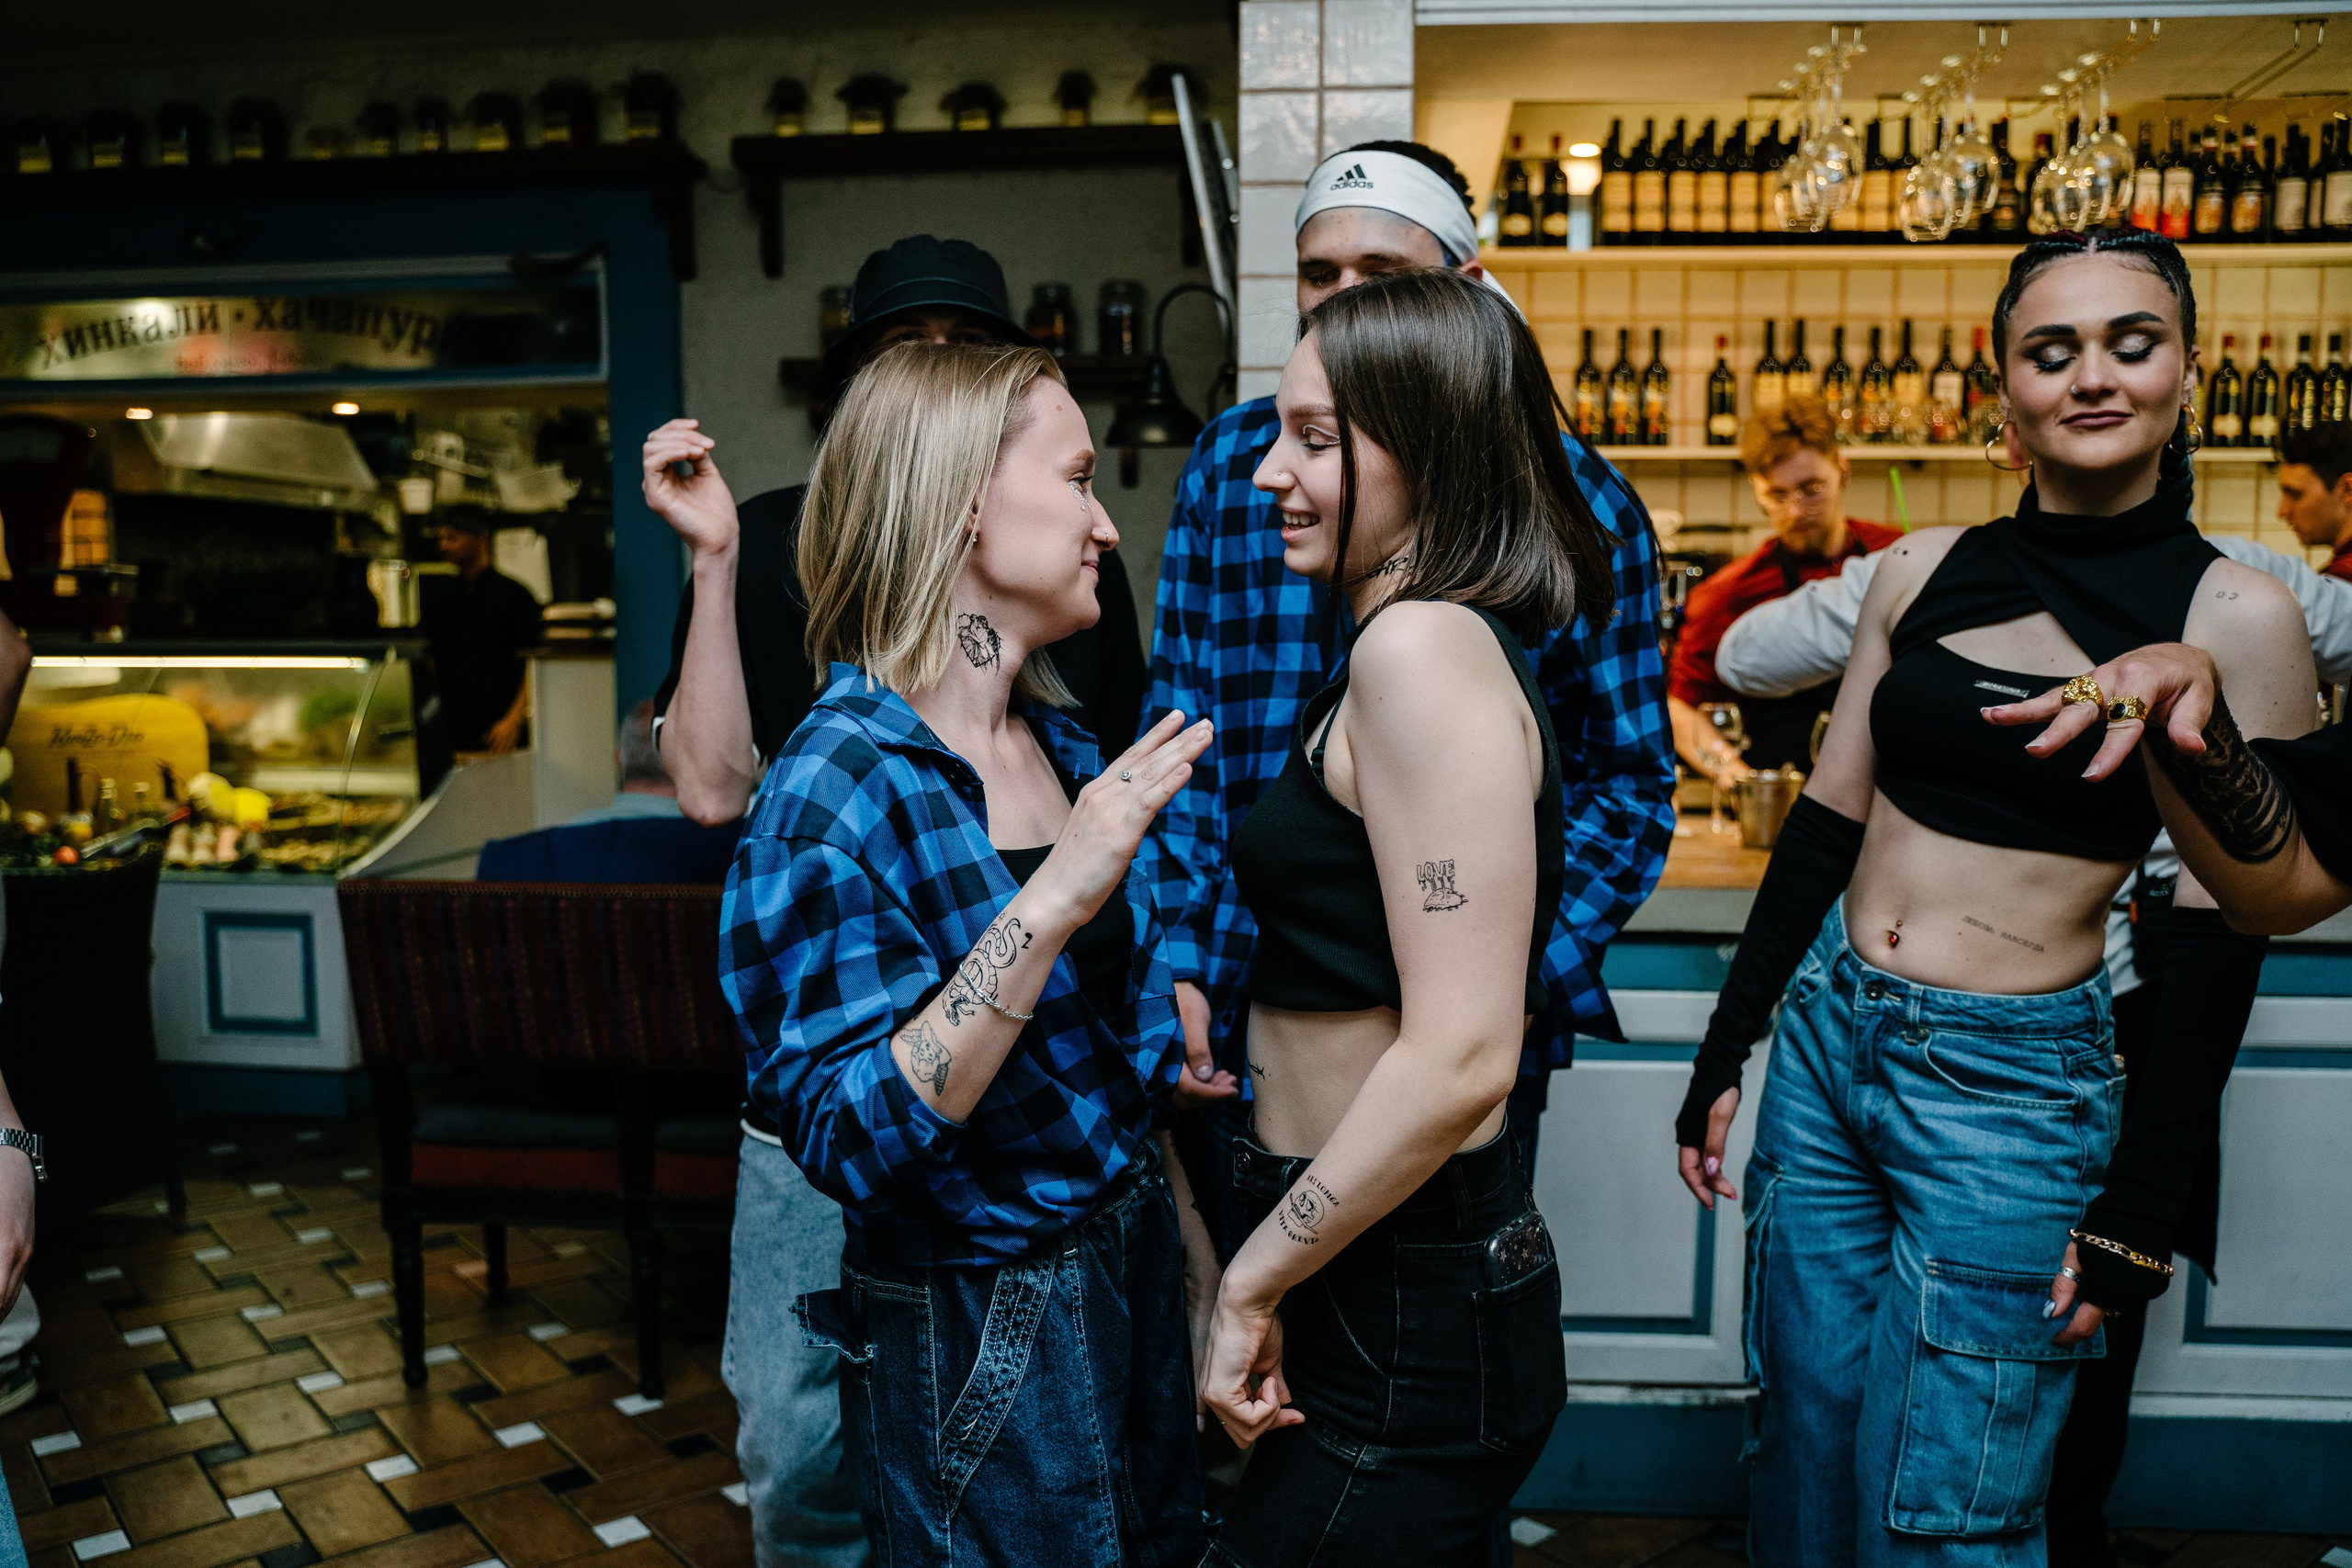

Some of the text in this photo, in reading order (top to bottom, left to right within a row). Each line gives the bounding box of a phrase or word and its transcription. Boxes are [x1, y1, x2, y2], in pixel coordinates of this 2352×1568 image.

[1329, 178, 1374, 191] adidas
[39, 303, 221, 370] хинкали
[1416, 859, 1456, 884] LOVE
[1317, 1181, 1340, 1208] LONGA
[1278, 1209, 1289, 1233] VITA
